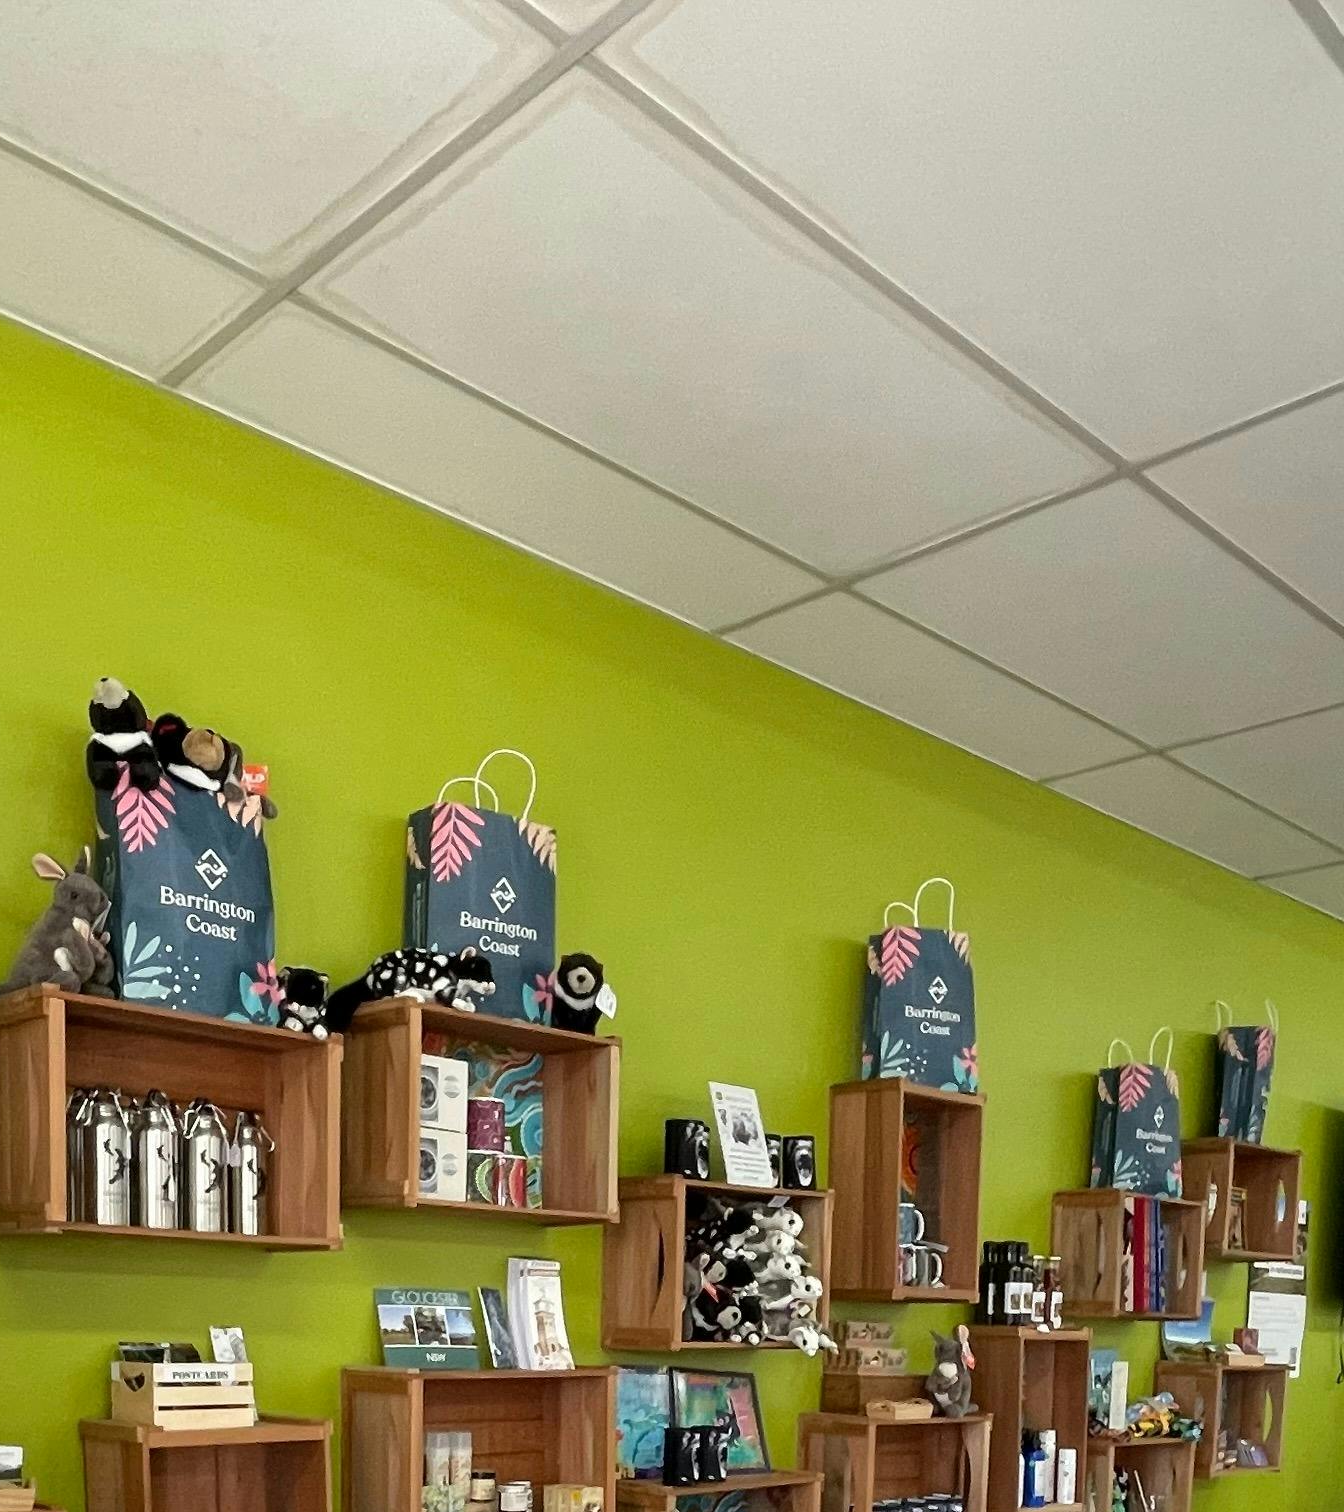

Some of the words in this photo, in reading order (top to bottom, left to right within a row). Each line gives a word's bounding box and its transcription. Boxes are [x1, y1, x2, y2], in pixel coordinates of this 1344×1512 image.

[159, 884, 256, 925] Barrington
[185, 913, 238, 942] Coast
[459, 910, 538, 941] Barrington
[479, 935, 520, 958] Coast
[904, 1004, 961, 1024] Barrington
[919, 1022, 951, 1036] Coast
[171, 1369, 230, 1381] POSTCARDS
